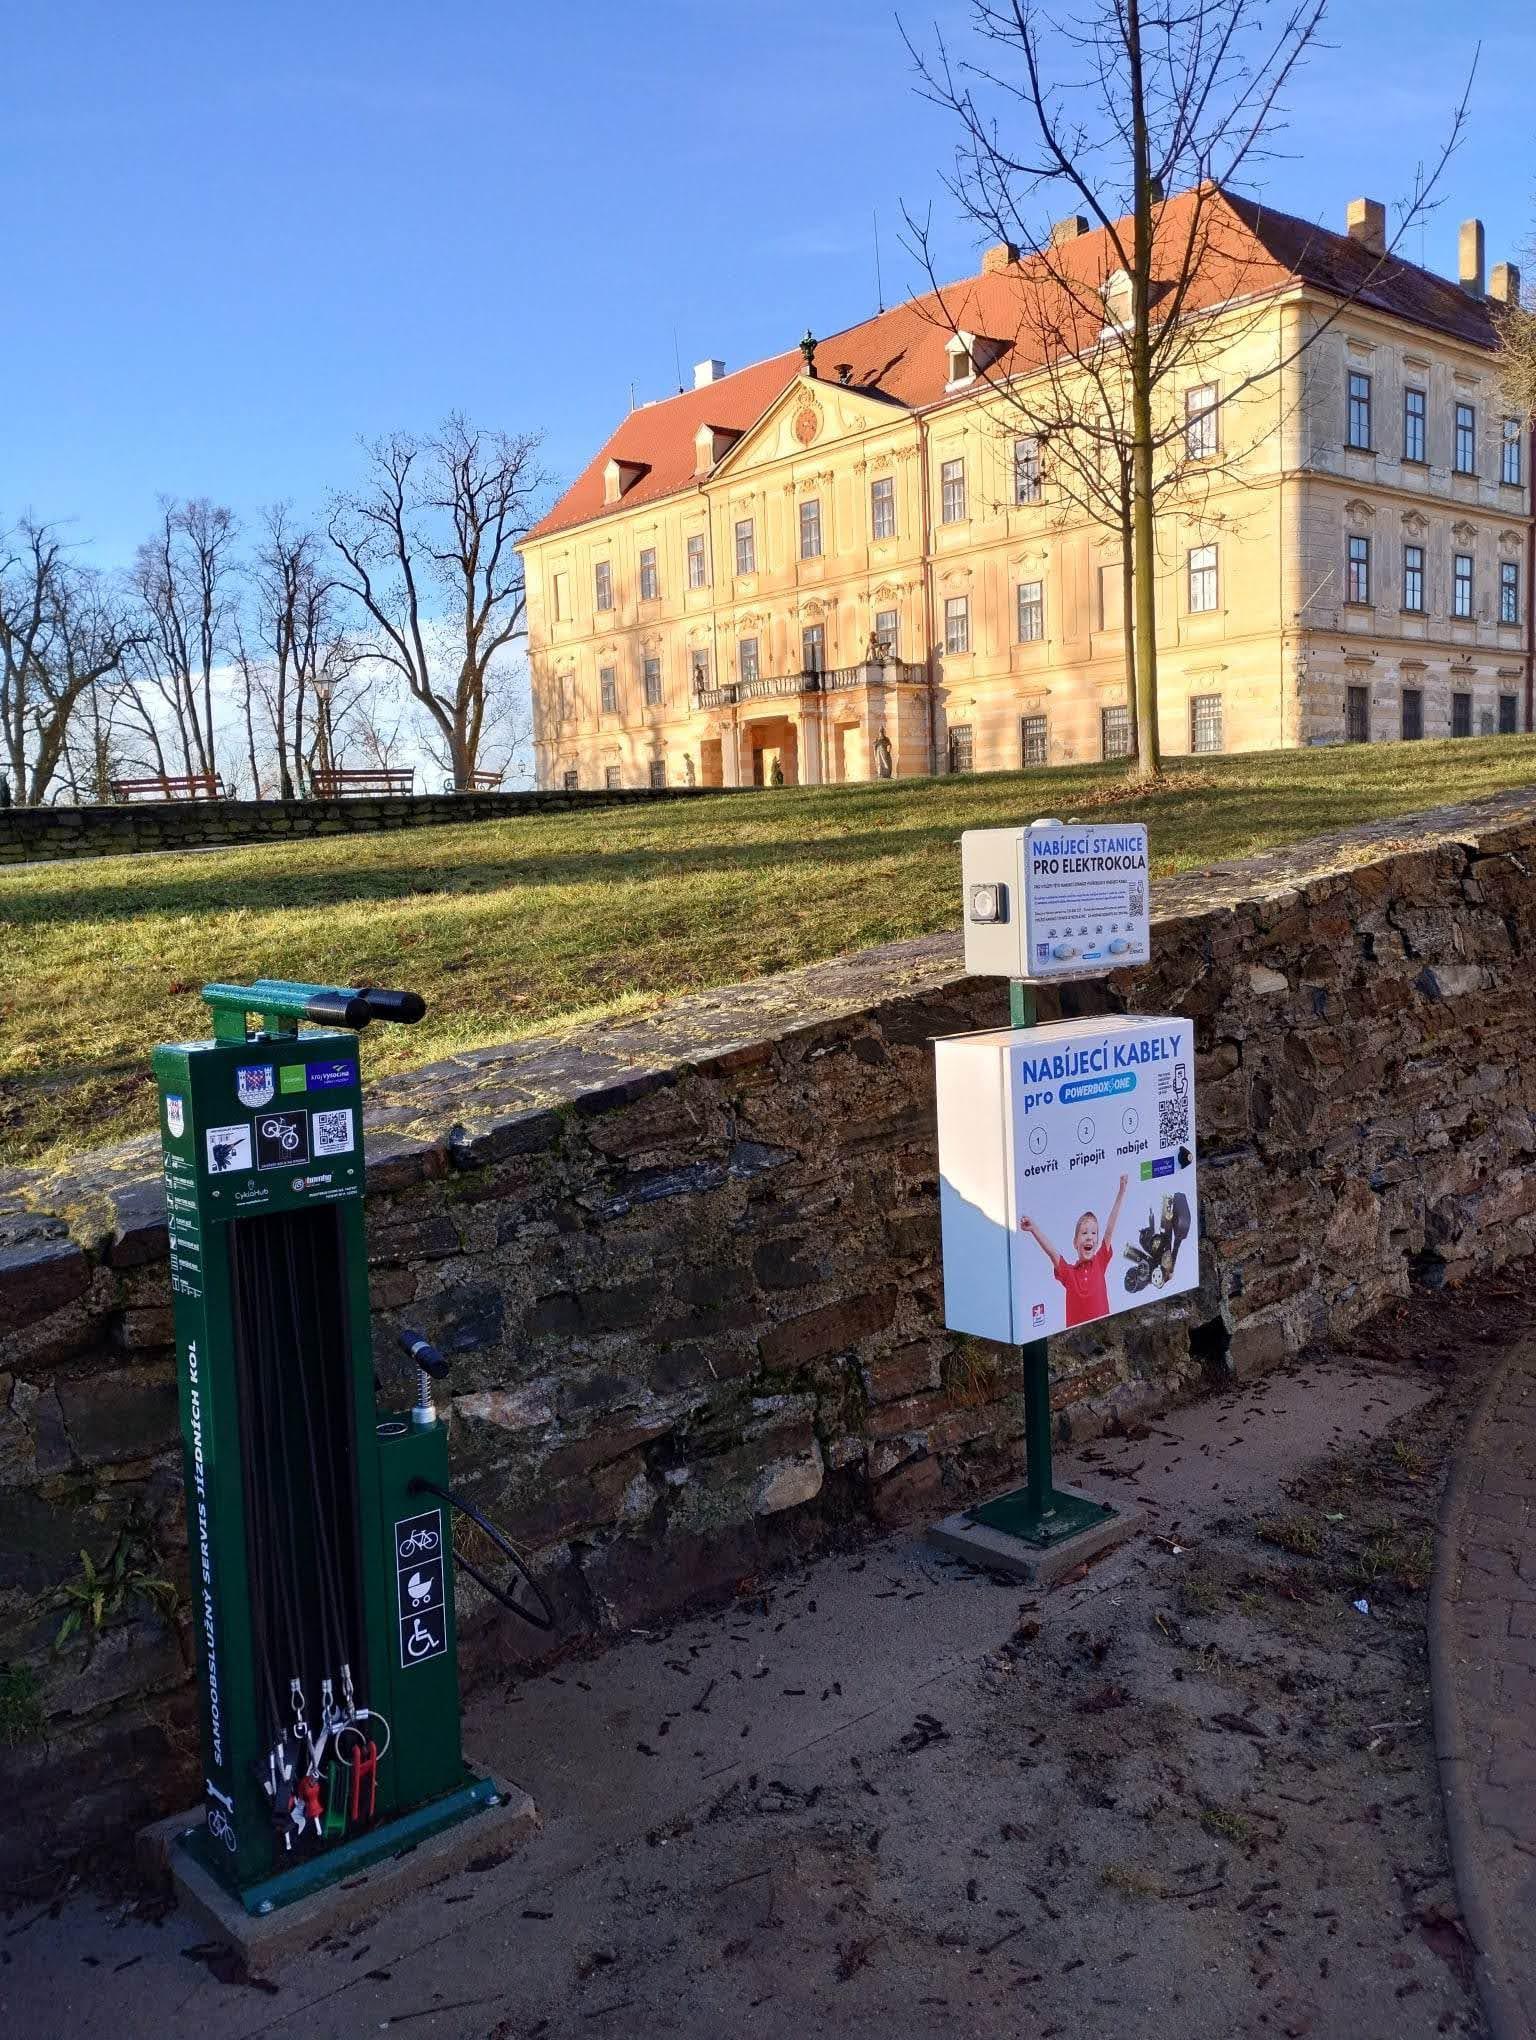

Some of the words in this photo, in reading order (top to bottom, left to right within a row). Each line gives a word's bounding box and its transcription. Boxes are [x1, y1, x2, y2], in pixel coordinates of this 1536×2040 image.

[1033, 835, 1089, 856] NABÍJECÍ
[1093, 837, 1143, 853] STANICE
[1033, 859, 1059, 875] PRO
[1062, 855, 1146, 873] ELEKTROKOLA
[1023, 1040, 1108, 1084] NABÍJECÍ
[1114, 1035, 1181, 1068] KABELY
[1024, 1091, 1054, 1114] pro
[1114, 1077, 1131, 1089] ONE
[1084, 1127, 1089, 1135] 2
[1128, 1117, 1133, 1125] 3
[1024, 1159, 1059, 1177] otevřít
[1116, 1139, 1149, 1156] nabíjet
[188, 1340, 199, 1383] KOL
[190, 1389, 206, 1499] JÍZDNÍCH
[199, 1502, 211, 1584] SERVIS
[202, 1589, 222, 1767] SAMOOBSLUŽNÝ
